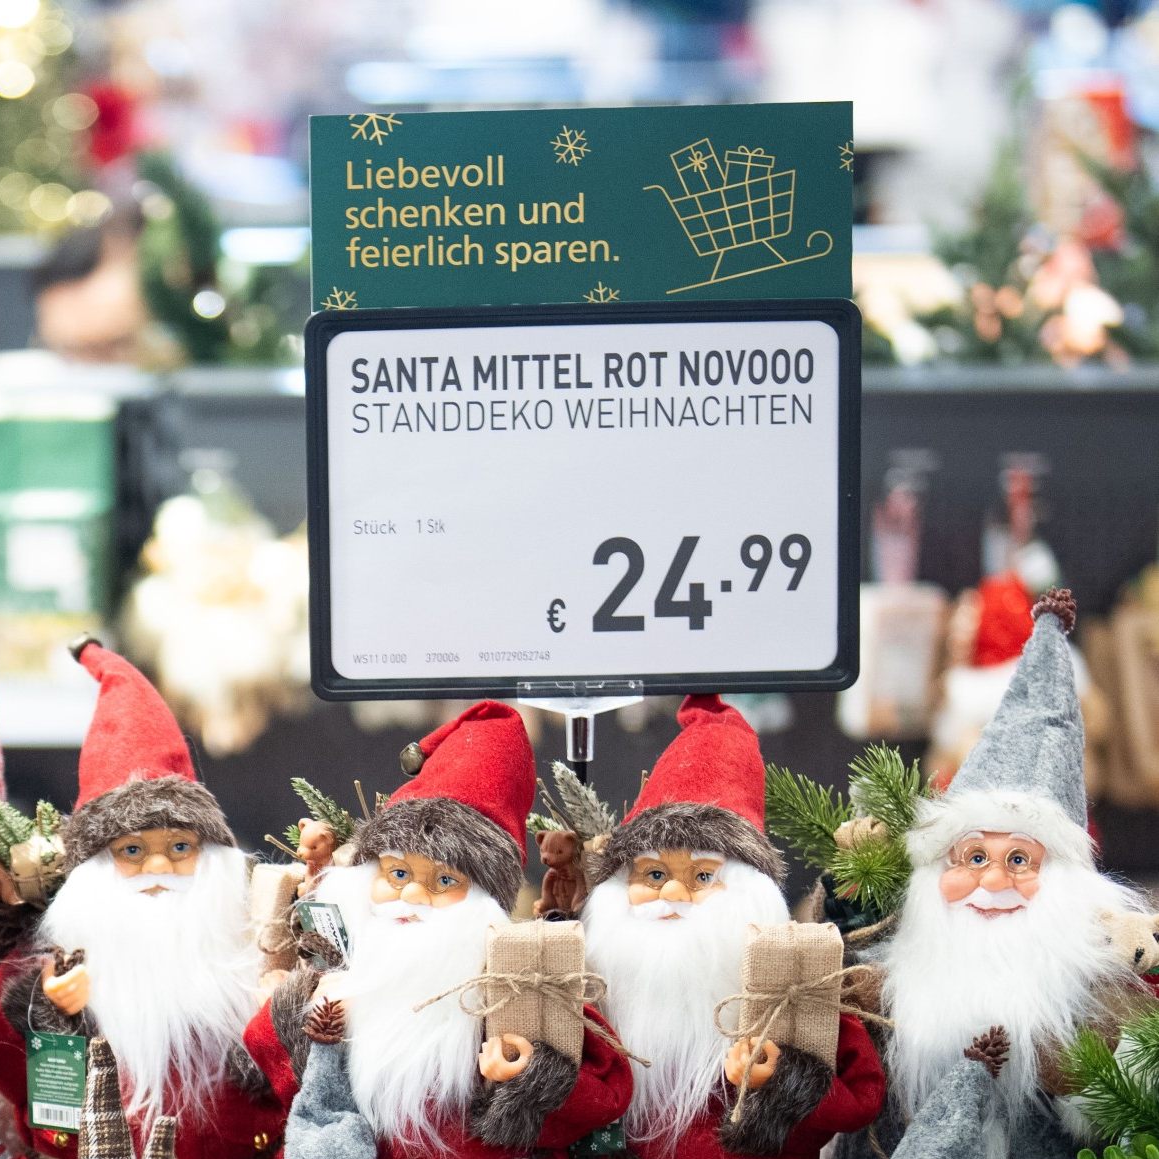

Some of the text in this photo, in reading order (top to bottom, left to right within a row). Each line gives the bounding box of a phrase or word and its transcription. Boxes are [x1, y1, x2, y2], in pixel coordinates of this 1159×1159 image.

[346, 154, 505, 190] Liebevoll
[345, 192, 586, 229] schenken und
[345, 234, 621, 273] feierlich sparen.
[350, 355, 463, 394] SANTA
[472, 352, 593, 392] MITTEL
[603, 351, 669, 389] ROT
[352, 393, 813, 434] STANDDEKO WEIHNACHTEN
[352, 519, 397, 536] Stück
[426, 518, 446, 535] Stk
[546, 533, 813, 635] € 24.99
[478, 650, 551, 663] 9010729052748
